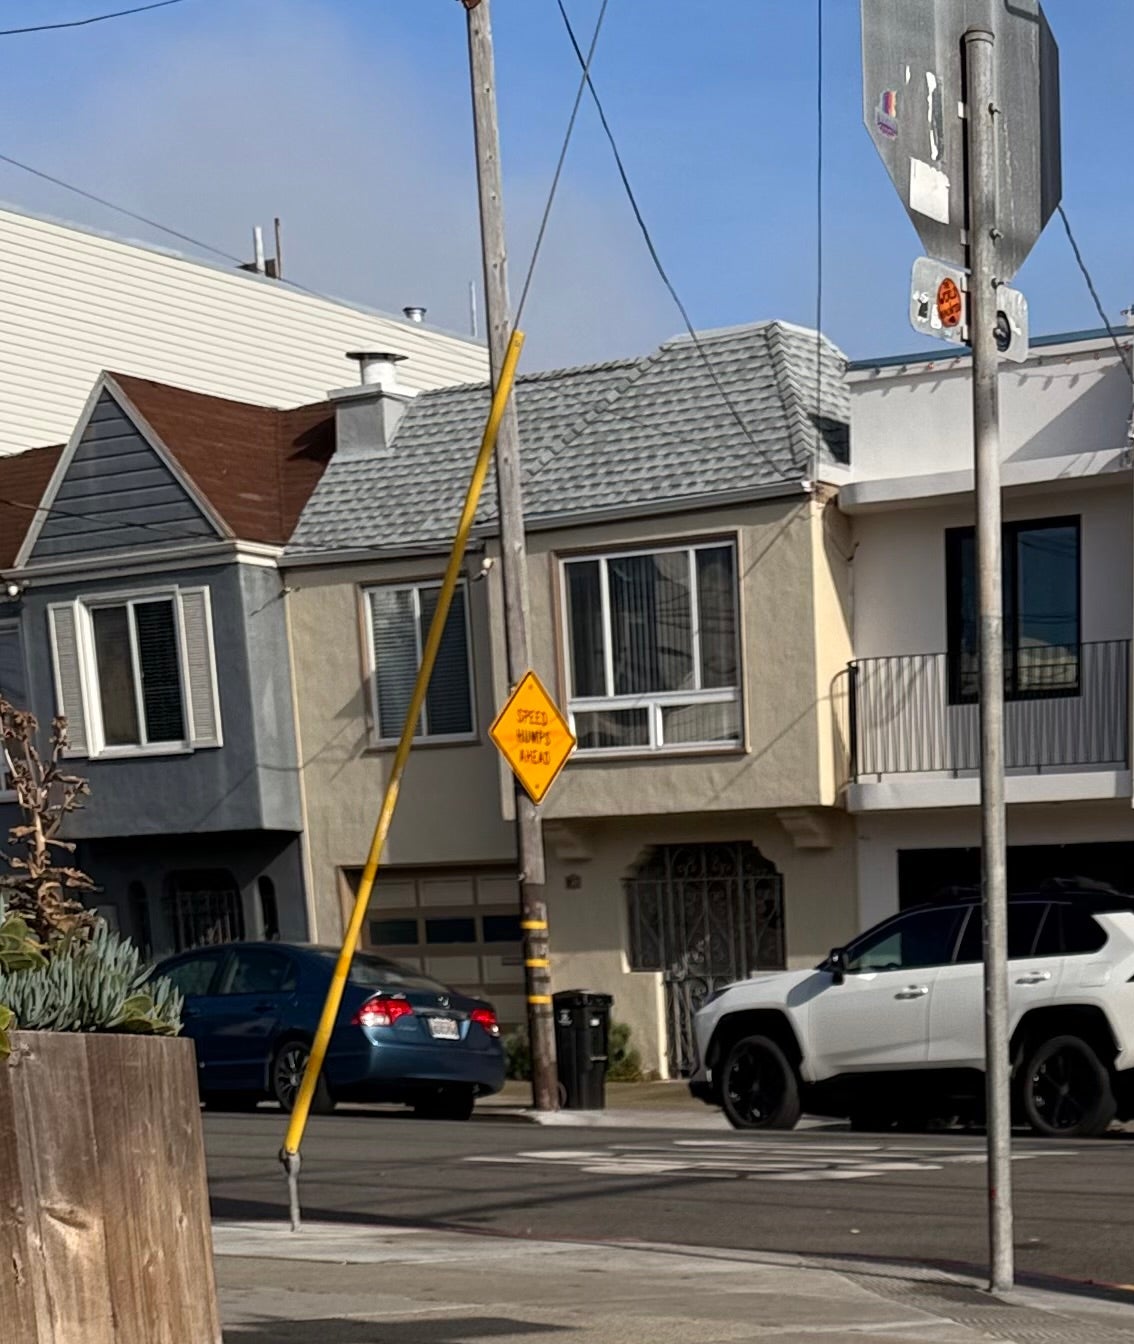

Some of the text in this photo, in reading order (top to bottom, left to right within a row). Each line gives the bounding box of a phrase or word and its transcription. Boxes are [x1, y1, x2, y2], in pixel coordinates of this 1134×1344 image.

[516, 708, 548, 726] SPEED
[516, 729, 551, 746] HUMPS
[519, 748, 551, 766] AHEAD
